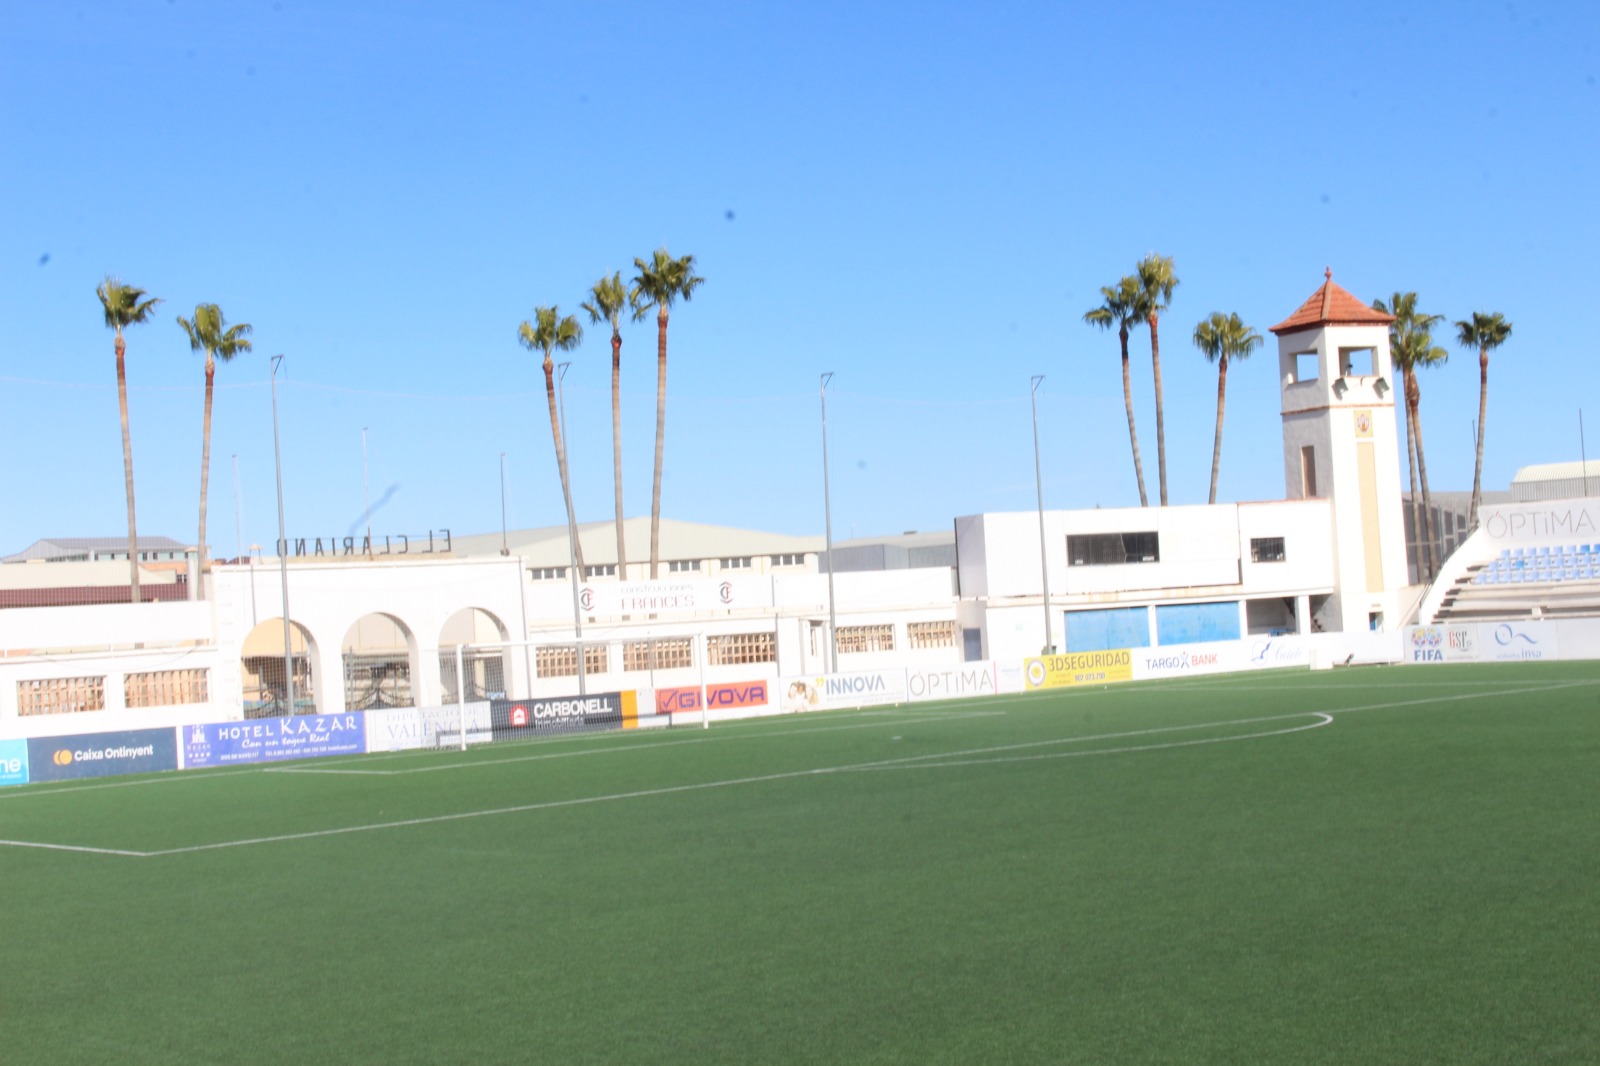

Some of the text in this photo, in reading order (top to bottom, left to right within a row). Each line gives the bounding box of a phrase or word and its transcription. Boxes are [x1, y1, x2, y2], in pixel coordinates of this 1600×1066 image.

[1049, 652, 1130, 672] 3DSEGURIDAD
[1414, 649, 1443, 661] FIFA
[826, 675, 886, 695] INNOVA
[533, 697, 613, 718] CARBONELL
[678, 686, 765, 709] GIVOVA
[218, 715, 357, 741] HOTEL KAZAR
[310, 733, 330, 743] Real
[74, 744, 153, 762] Caixa Ontinyent
